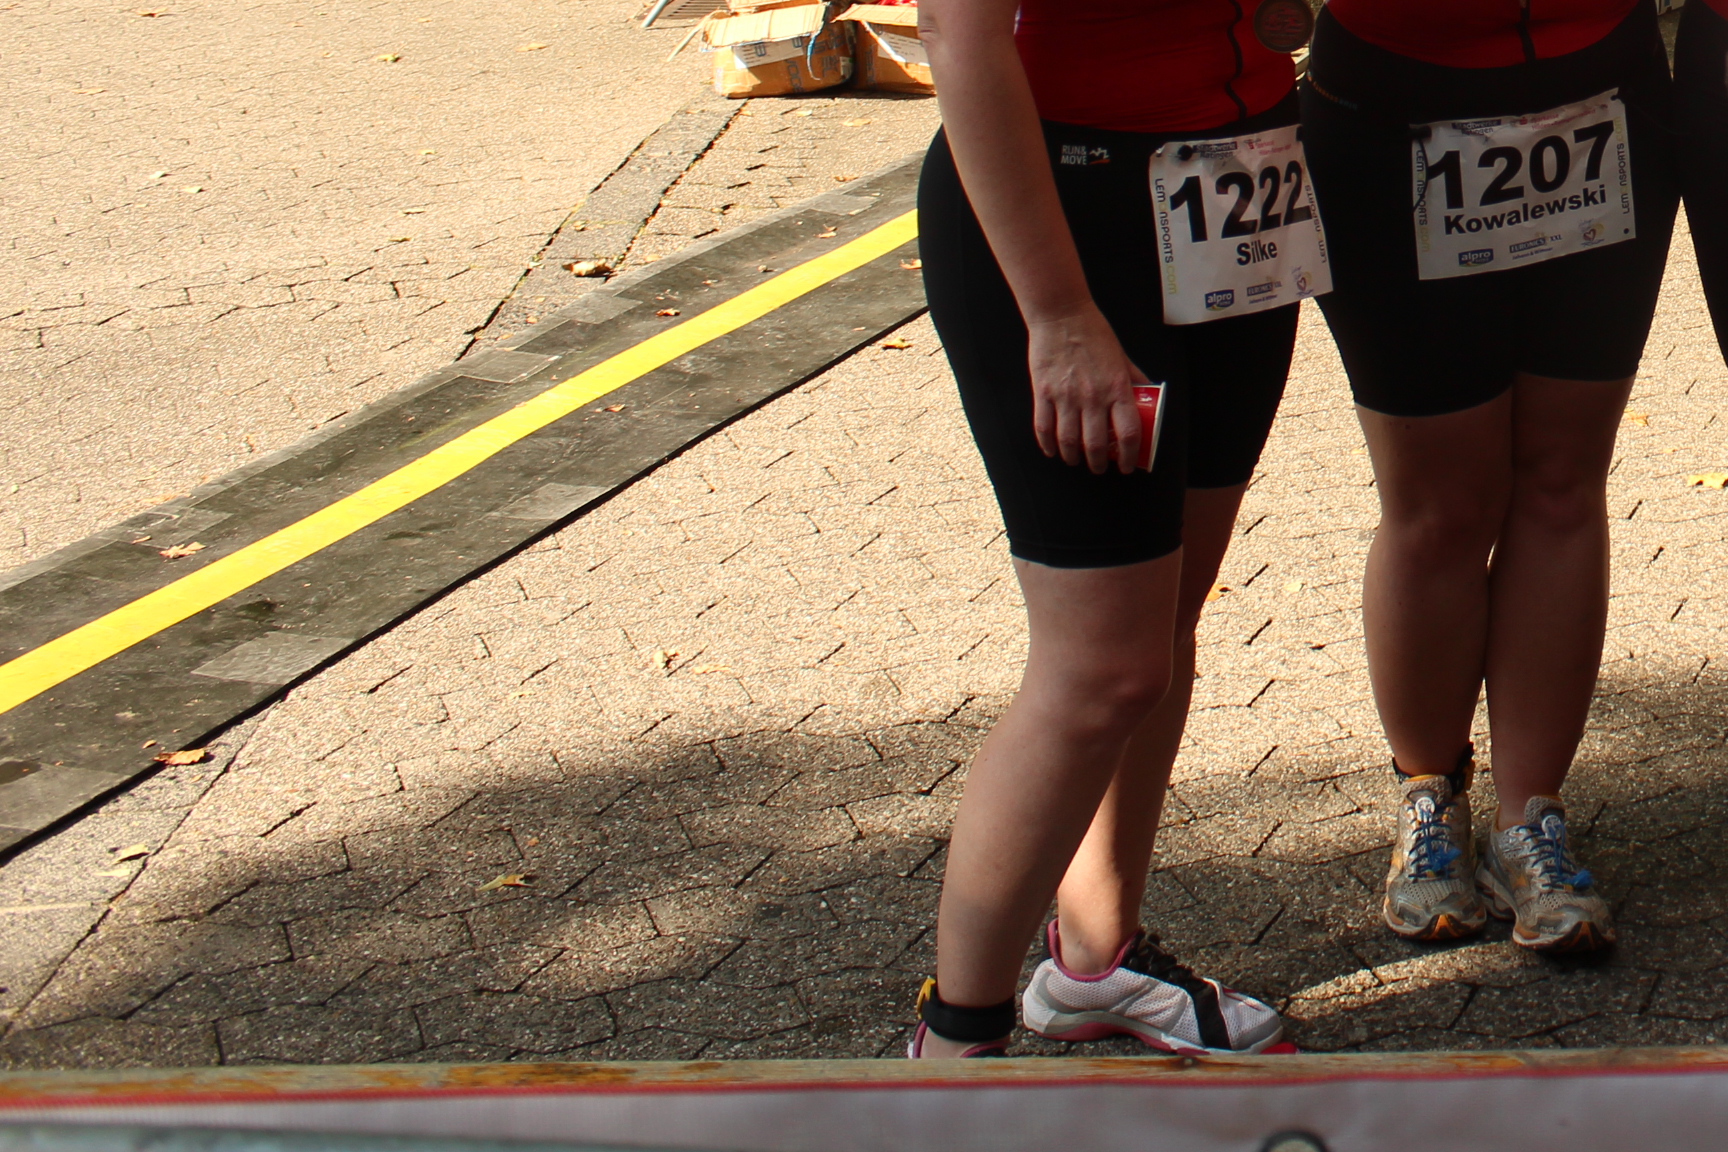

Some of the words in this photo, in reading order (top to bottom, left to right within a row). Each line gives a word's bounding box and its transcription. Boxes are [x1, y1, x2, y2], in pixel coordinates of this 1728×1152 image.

[1060, 155, 1087, 165] MOVE
[1427, 120, 1615, 210] 1207
[1170, 160, 1312, 243] 1222
[1444, 184, 1607, 235] Kowalewski
[1237, 240, 1278, 266] Silke
[1461, 250, 1491, 262] alpro
[1207, 293, 1232, 305] alpro
